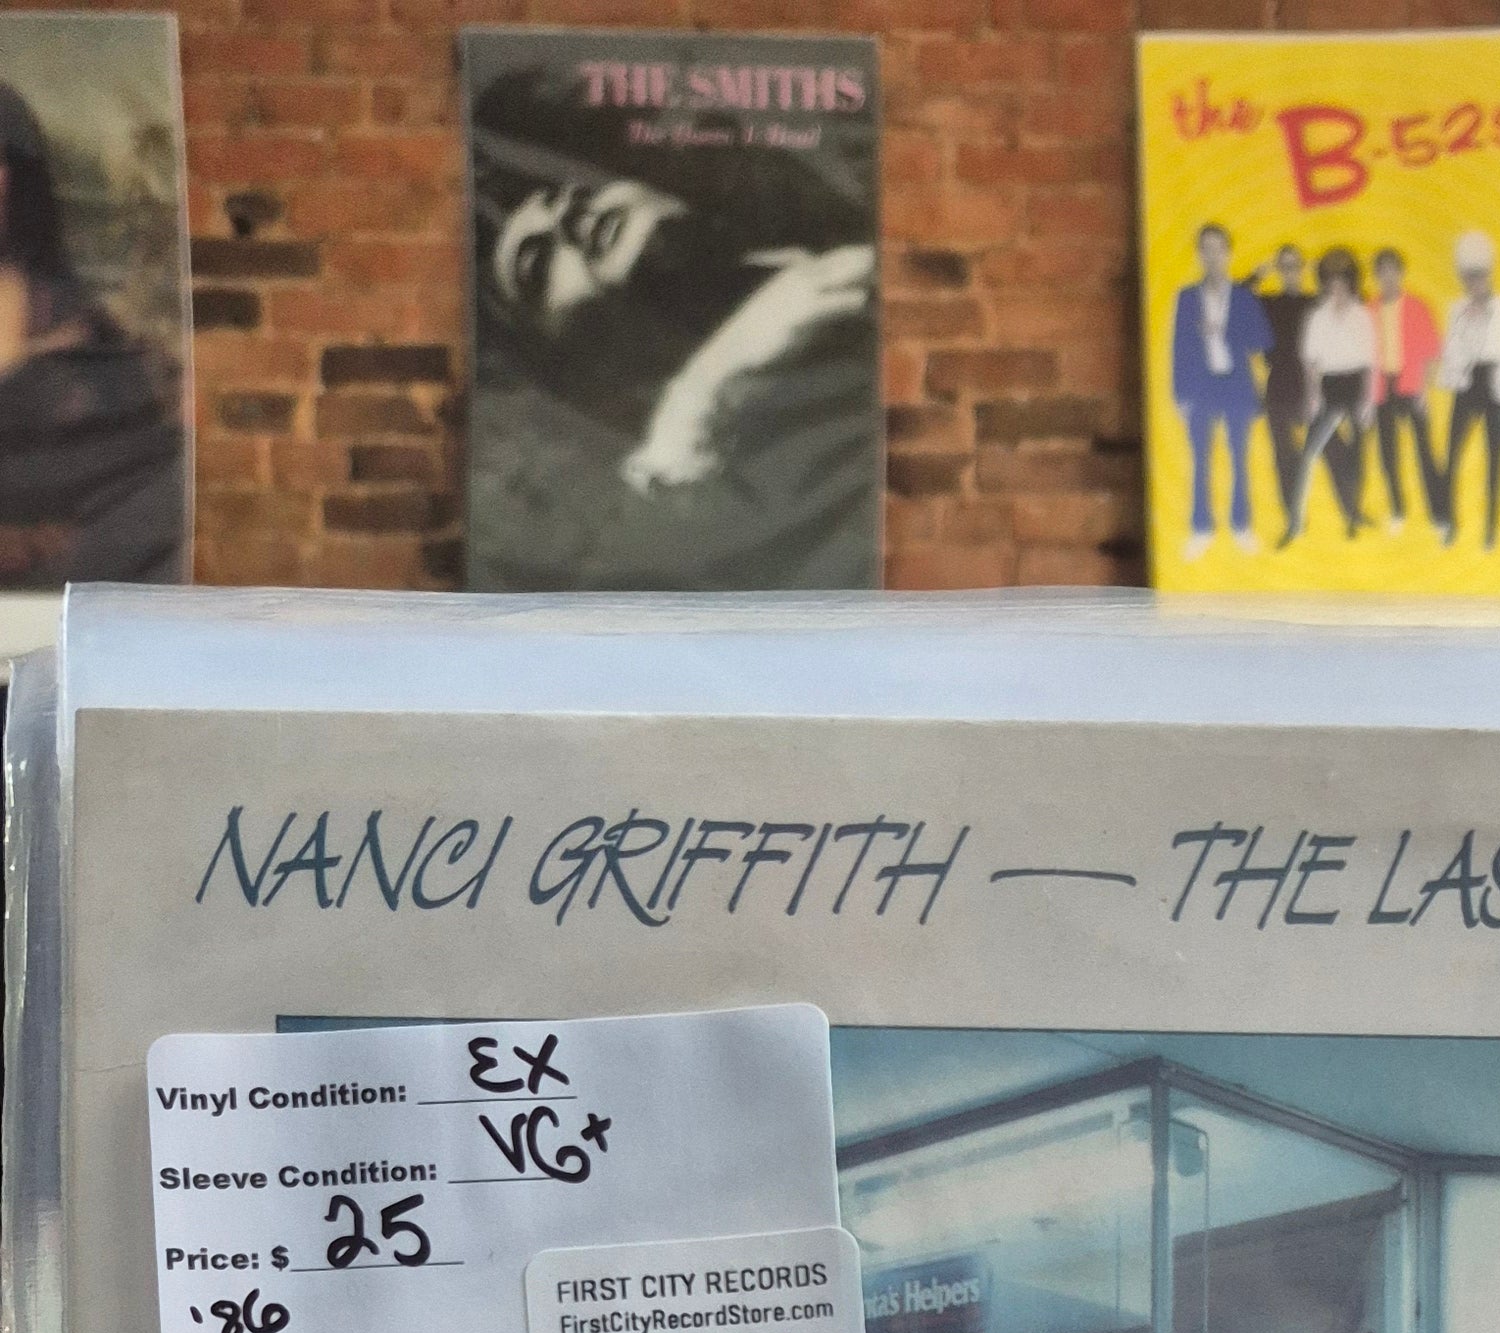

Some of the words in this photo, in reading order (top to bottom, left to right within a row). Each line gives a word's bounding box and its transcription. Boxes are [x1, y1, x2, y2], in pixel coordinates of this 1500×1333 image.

[580, 61, 672, 107] THE
[687, 66, 867, 111] SMITHS
[1171, 76, 1264, 142] the
[196, 805, 515, 911] NANCI
[528, 808, 971, 928] GRIFFITH
[1170, 821, 1359, 931] THE
[157, 1086, 238, 1116] Vinyl
[248, 1082, 406, 1110] Condition:
[159, 1166, 267, 1191] Sleeve
[277, 1160, 438, 1188] Condition:
[165, 1245, 260, 1272] Price:
[323, 1193, 432, 1268] 25
[556, 1274, 633, 1304] FIRST
[641, 1271, 697, 1300] CITY
[704, 1262, 828, 1296] RECORDS
